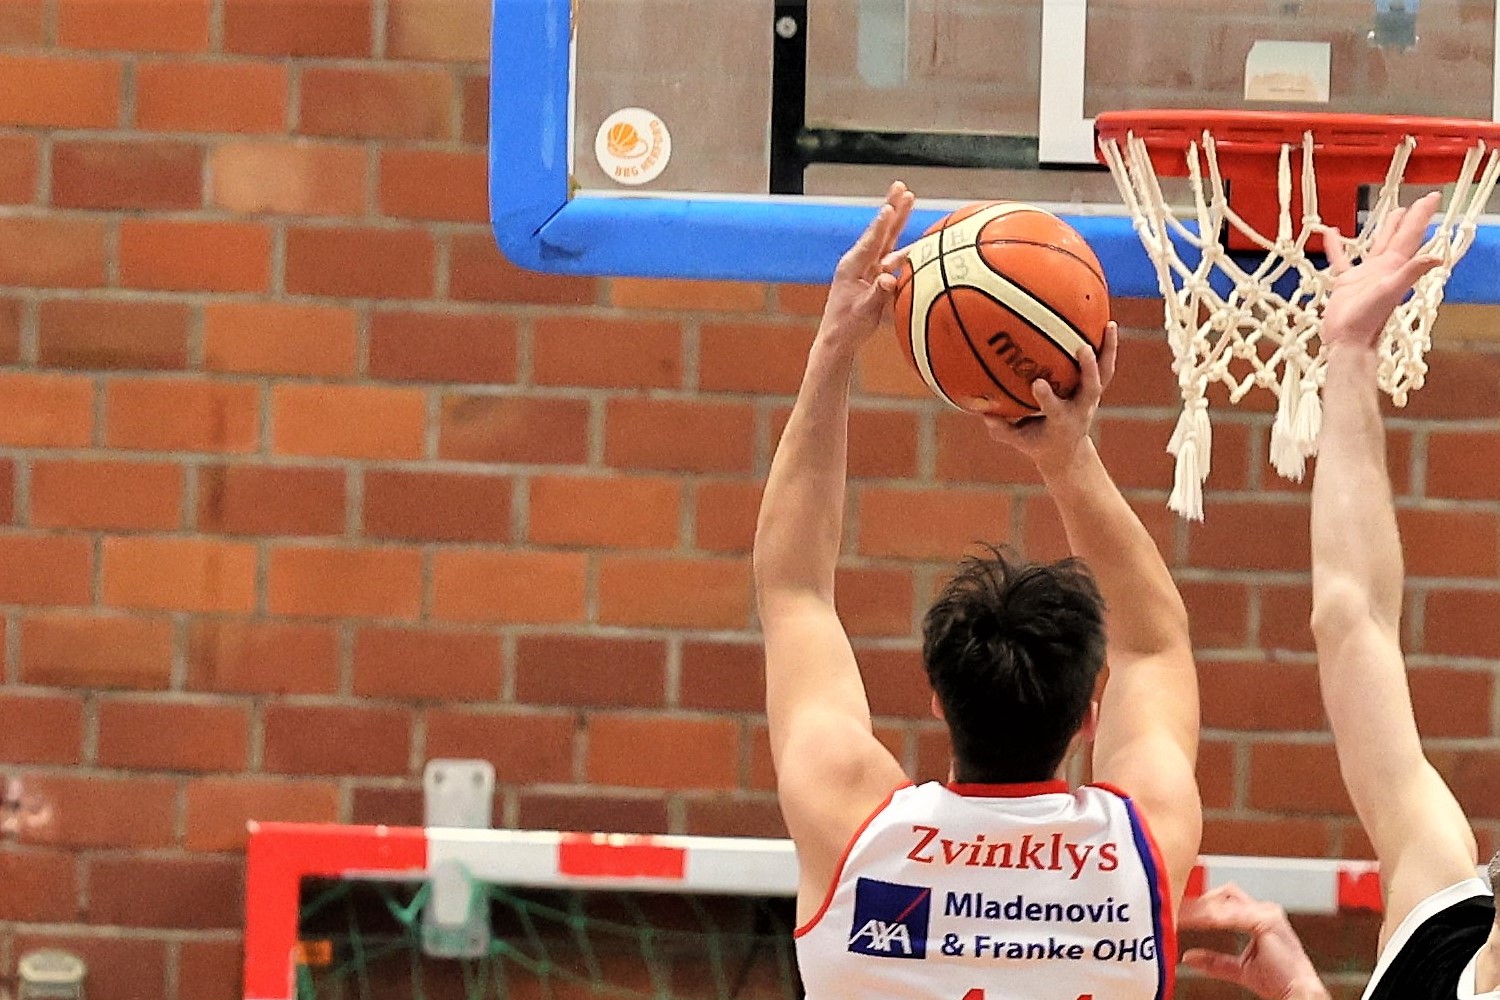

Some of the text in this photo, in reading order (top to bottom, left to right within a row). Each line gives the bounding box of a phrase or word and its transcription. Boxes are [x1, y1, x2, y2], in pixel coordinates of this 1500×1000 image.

[907, 825, 1119, 880] Zvinklys
[944, 891, 1130, 923] Mladenovic
[848, 918, 912, 955] AXA
[941, 933, 1156, 962] & Franke OHG
